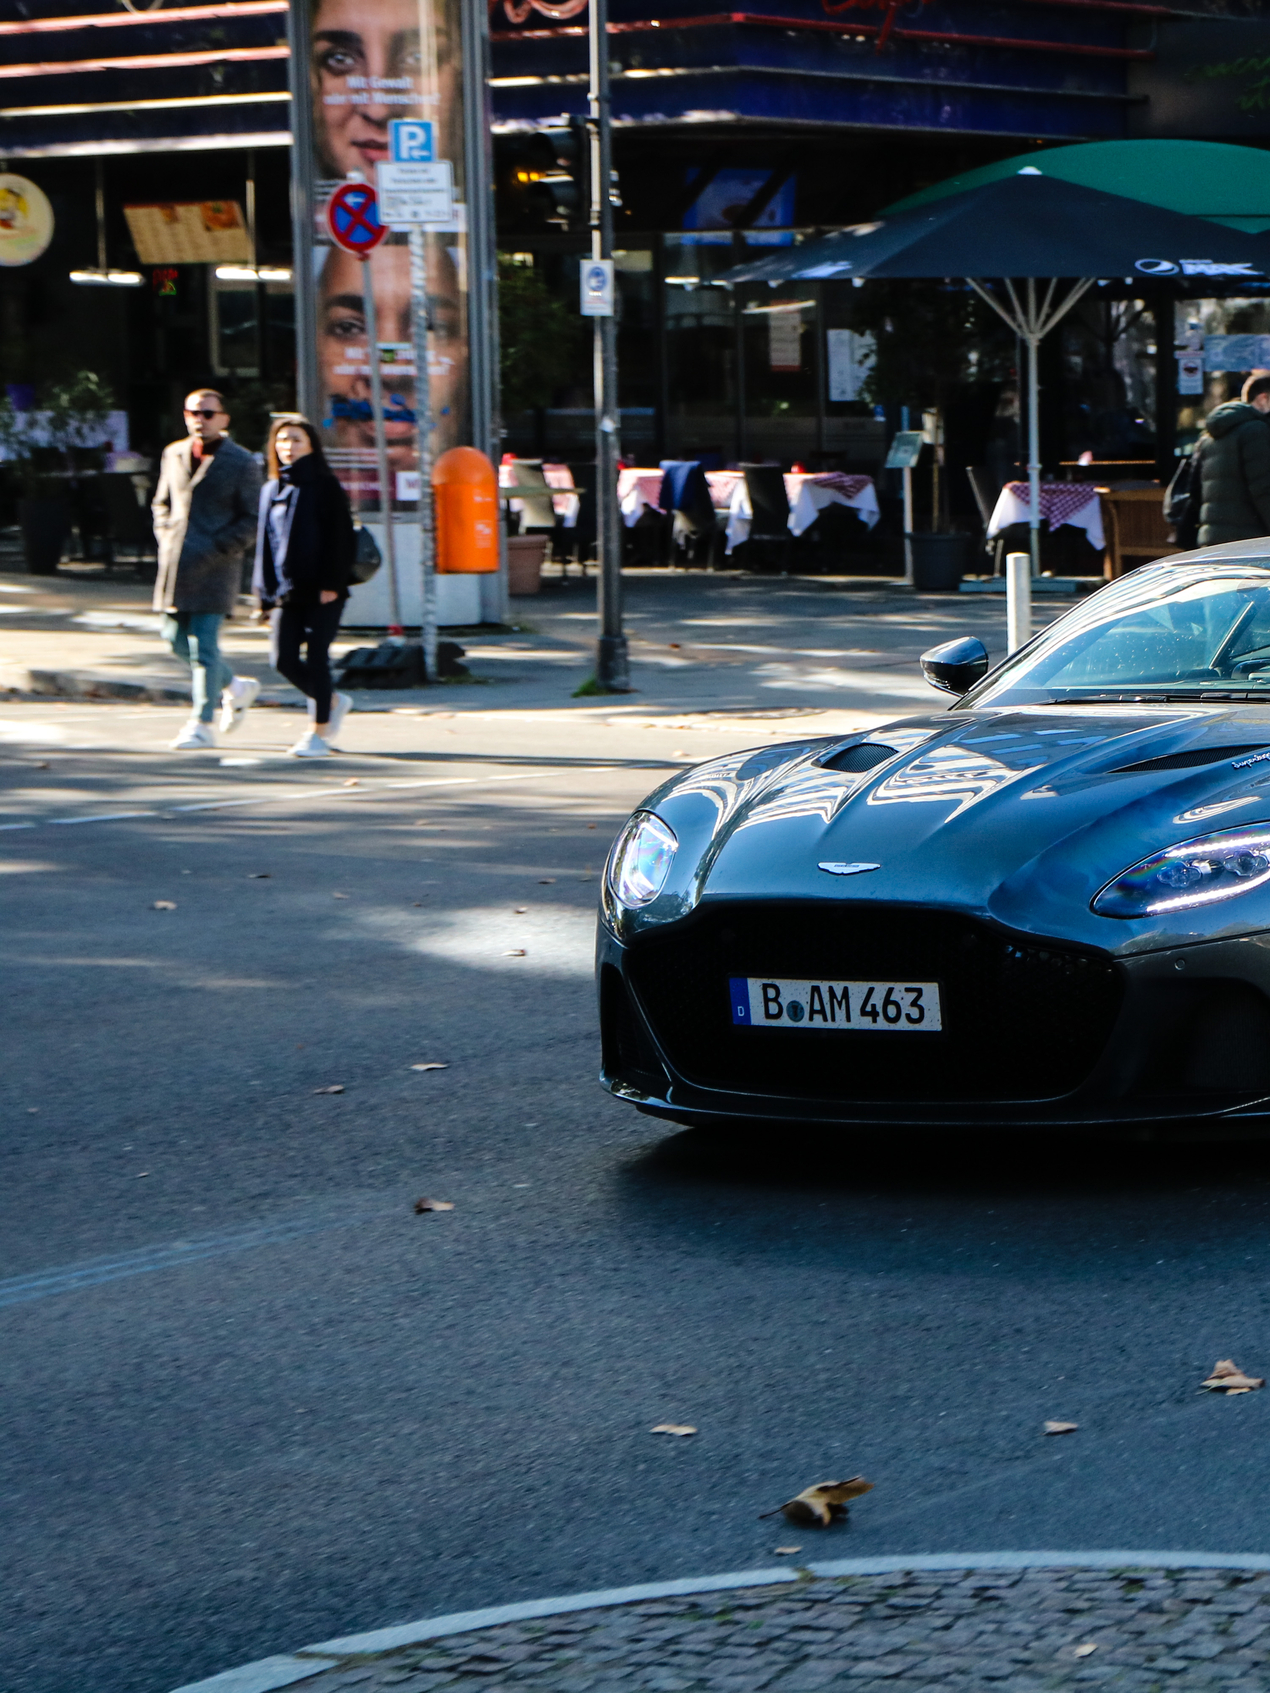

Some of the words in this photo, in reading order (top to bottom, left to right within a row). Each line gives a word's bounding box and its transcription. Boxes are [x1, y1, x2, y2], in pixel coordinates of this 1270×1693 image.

[398, 125, 426, 159] P
[737, 1006, 745, 1017] D
[762, 982, 784, 1020] B
[808, 984, 852, 1023] AM
[859, 986, 925, 1025] 463
